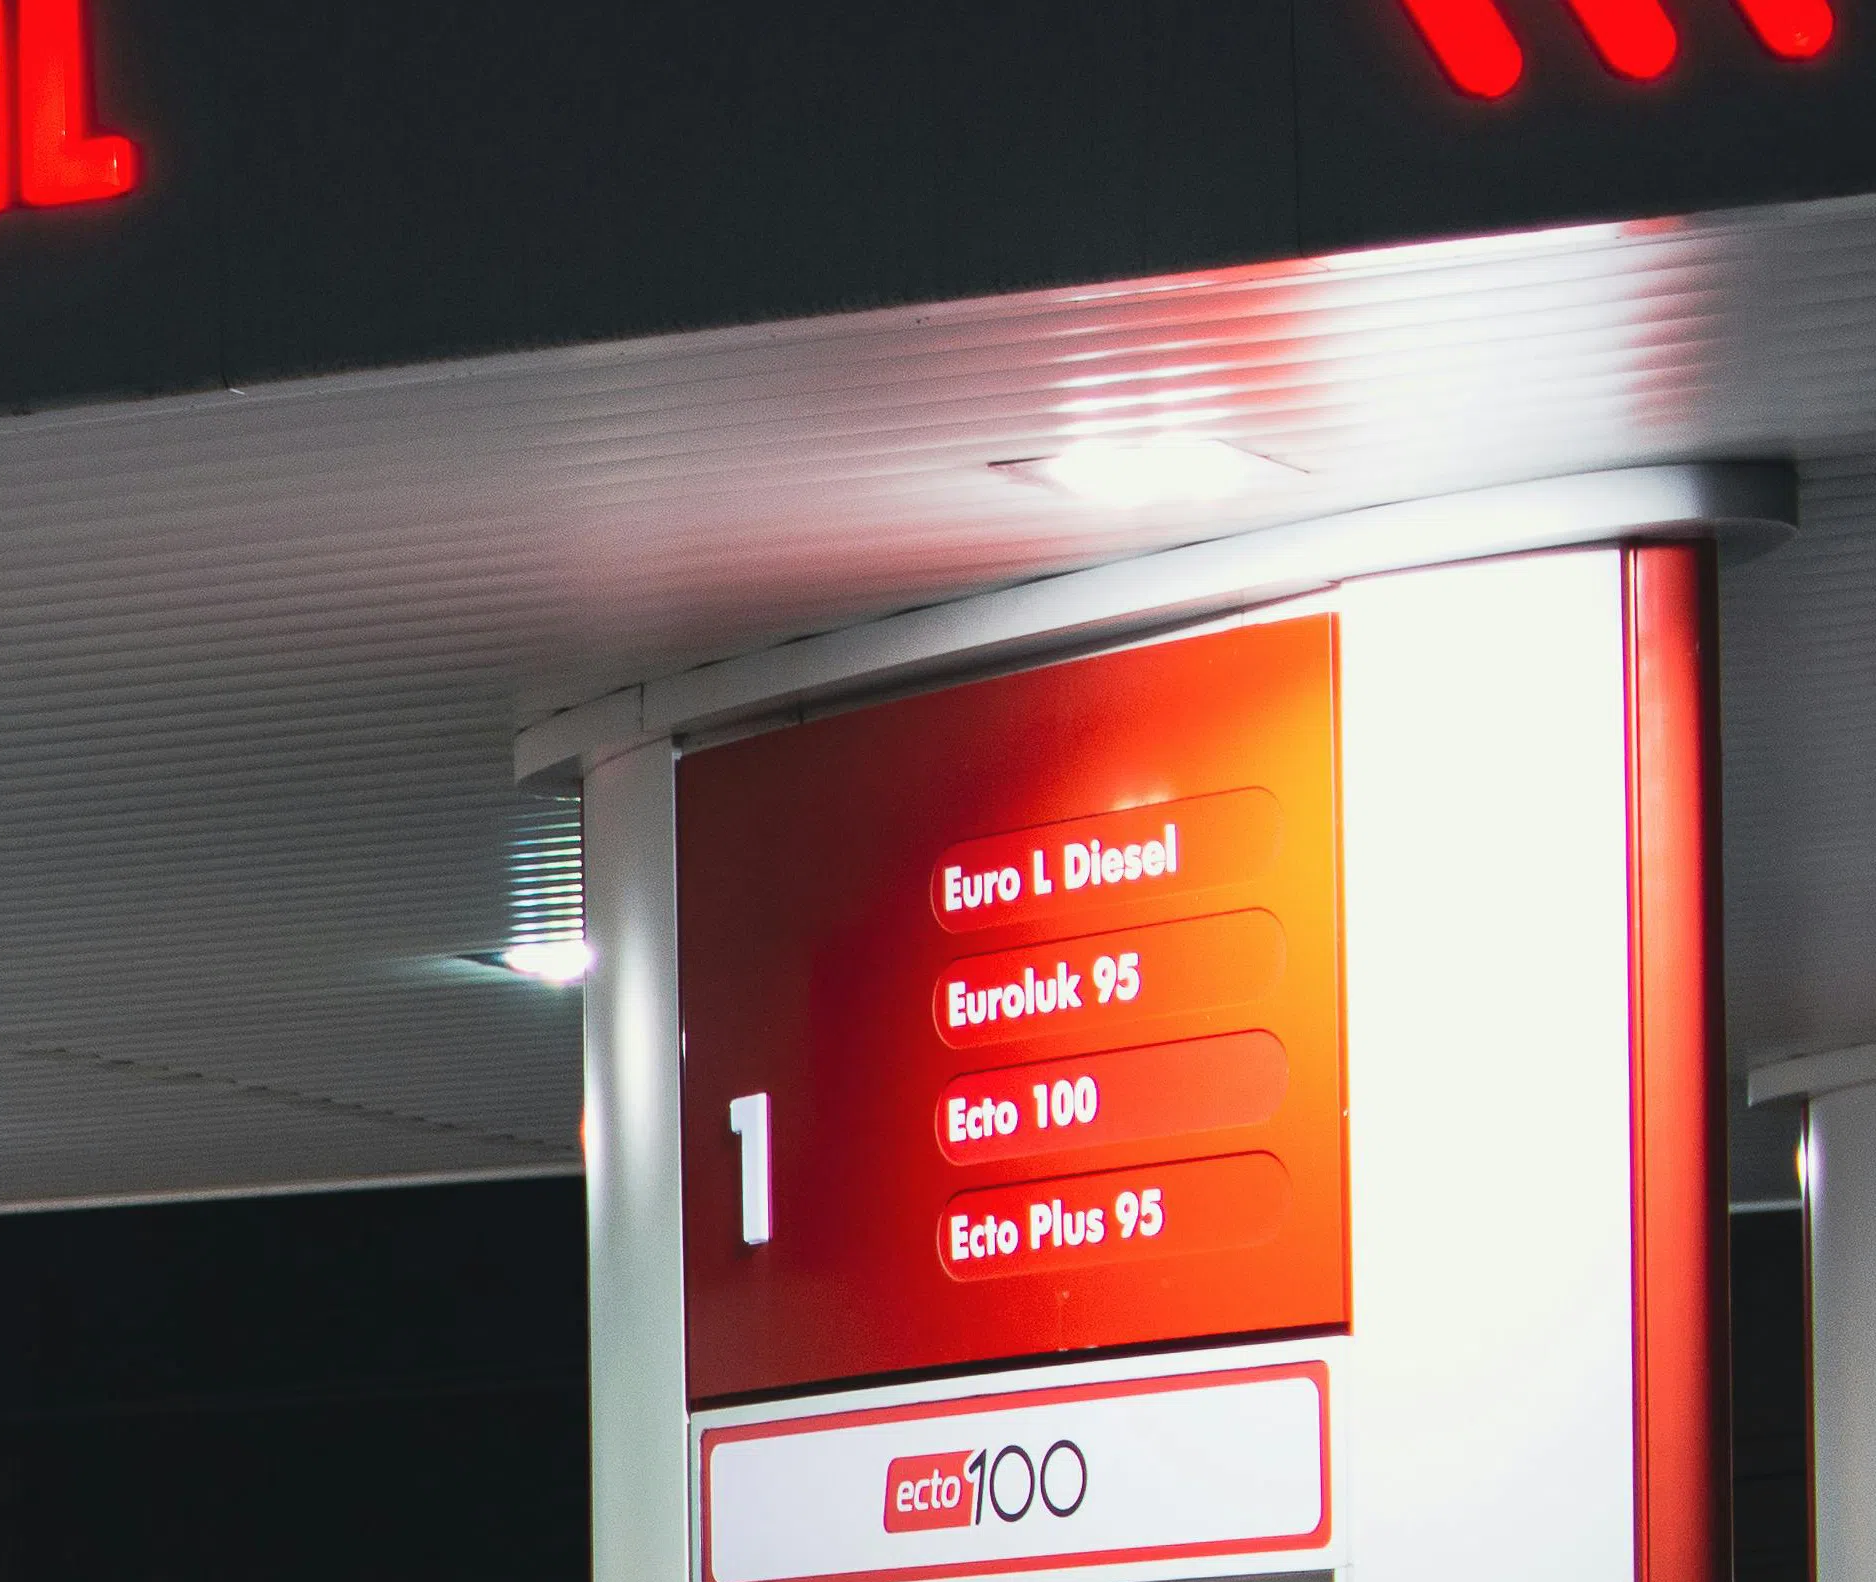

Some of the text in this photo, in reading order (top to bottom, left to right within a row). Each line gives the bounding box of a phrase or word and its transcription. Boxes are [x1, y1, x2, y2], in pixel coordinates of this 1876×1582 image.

[945, 824, 1178, 912] Euro L Diesel
[949, 952, 1141, 1027] Euroluk 95
[949, 1076, 1098, 1142] Ecto 100
[729, 1092, 772, 1245] 1
[951, 1188, 1164, 1261] Ecto Plus 95
